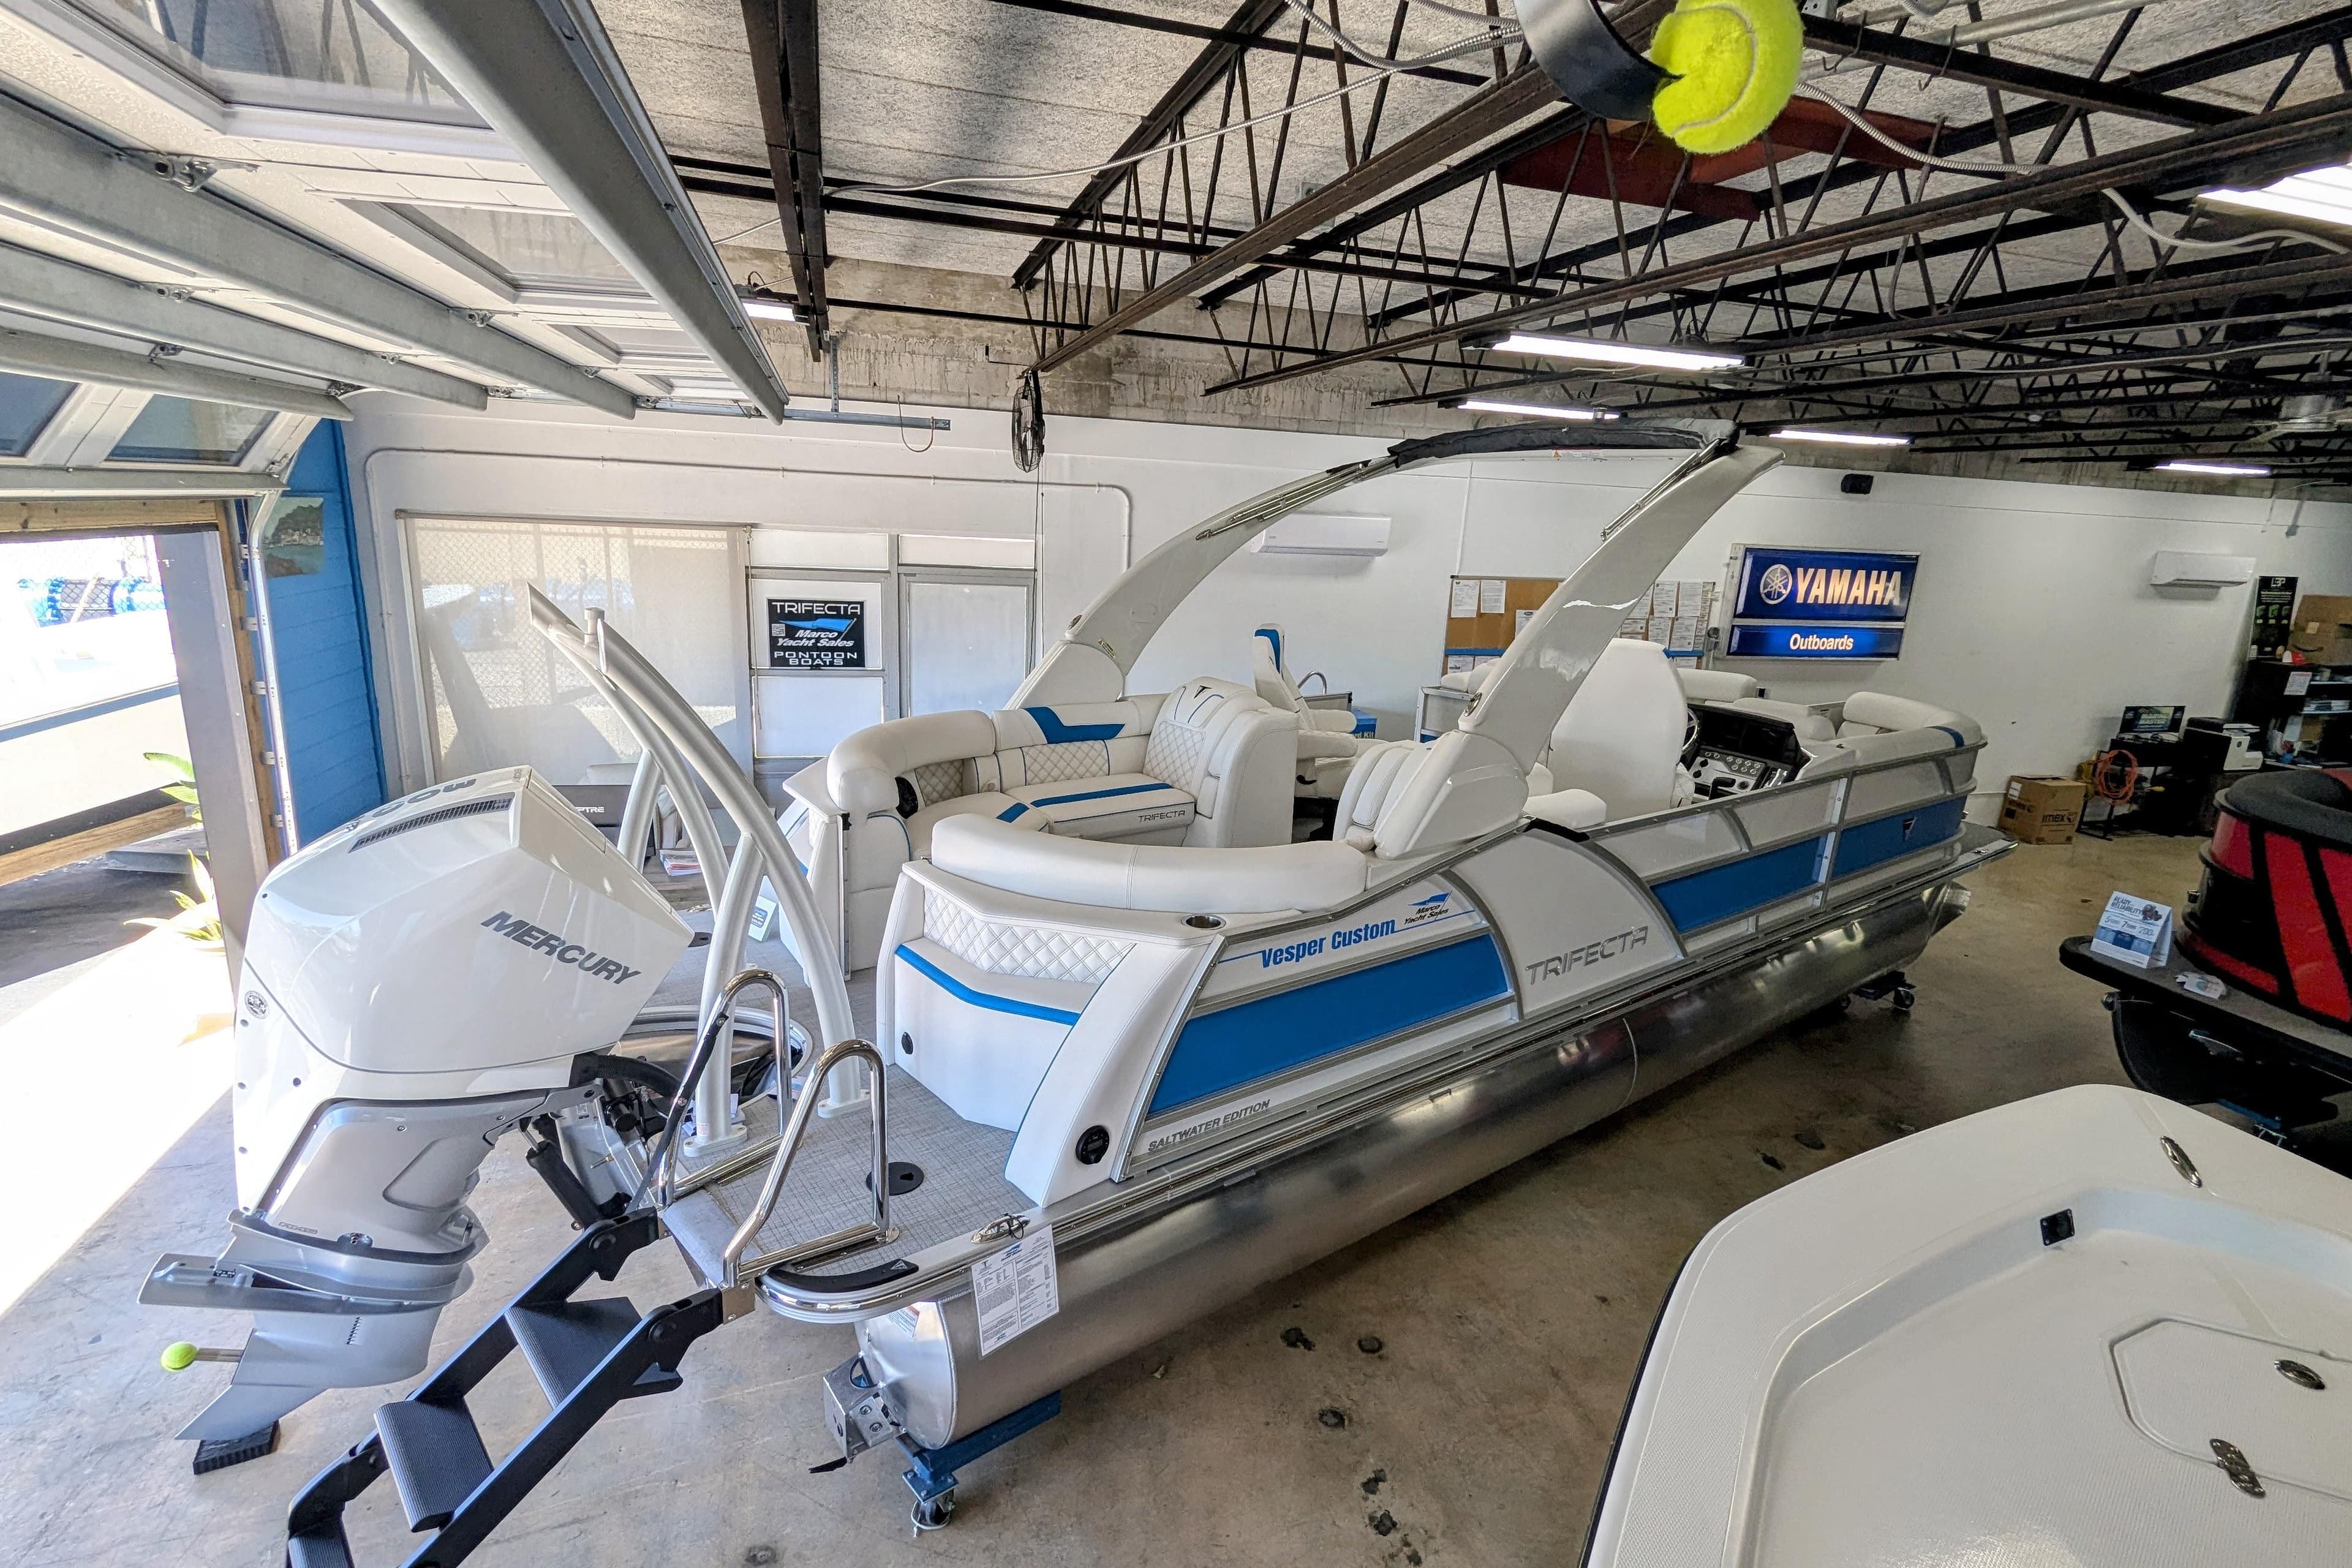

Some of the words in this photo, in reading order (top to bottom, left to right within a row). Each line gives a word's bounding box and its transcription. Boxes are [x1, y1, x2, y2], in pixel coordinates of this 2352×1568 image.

[1796, 567, 1901, 606] YAMAHA
[772, 602, 861, 615] TRIFECTA
[776, 638, 816, 647] Yacht
[817, 638, 854, 647] Sales
[795, 630, 839, 638] Marco
[1789, 633, 1854, 650] Outboards
[1137, 810, 1186, 822] TRIFECTA
[1404, 914, 1427, 925] Yacht
[1427, 908, 1449, 918] Sales
[1415, 905, 1441, 914] Marco
[480, 911, 641, 984] MERCURY
[1261, 937, 1327, 969] Vesper
[1331, 919, 1395, 950] Custom
[1525, 925, 1649, 986] TRIFECTA
[1148, 1117, 1220, 1152] SALTWATER
[1222, 1099, 1270, 1126] EDITION
